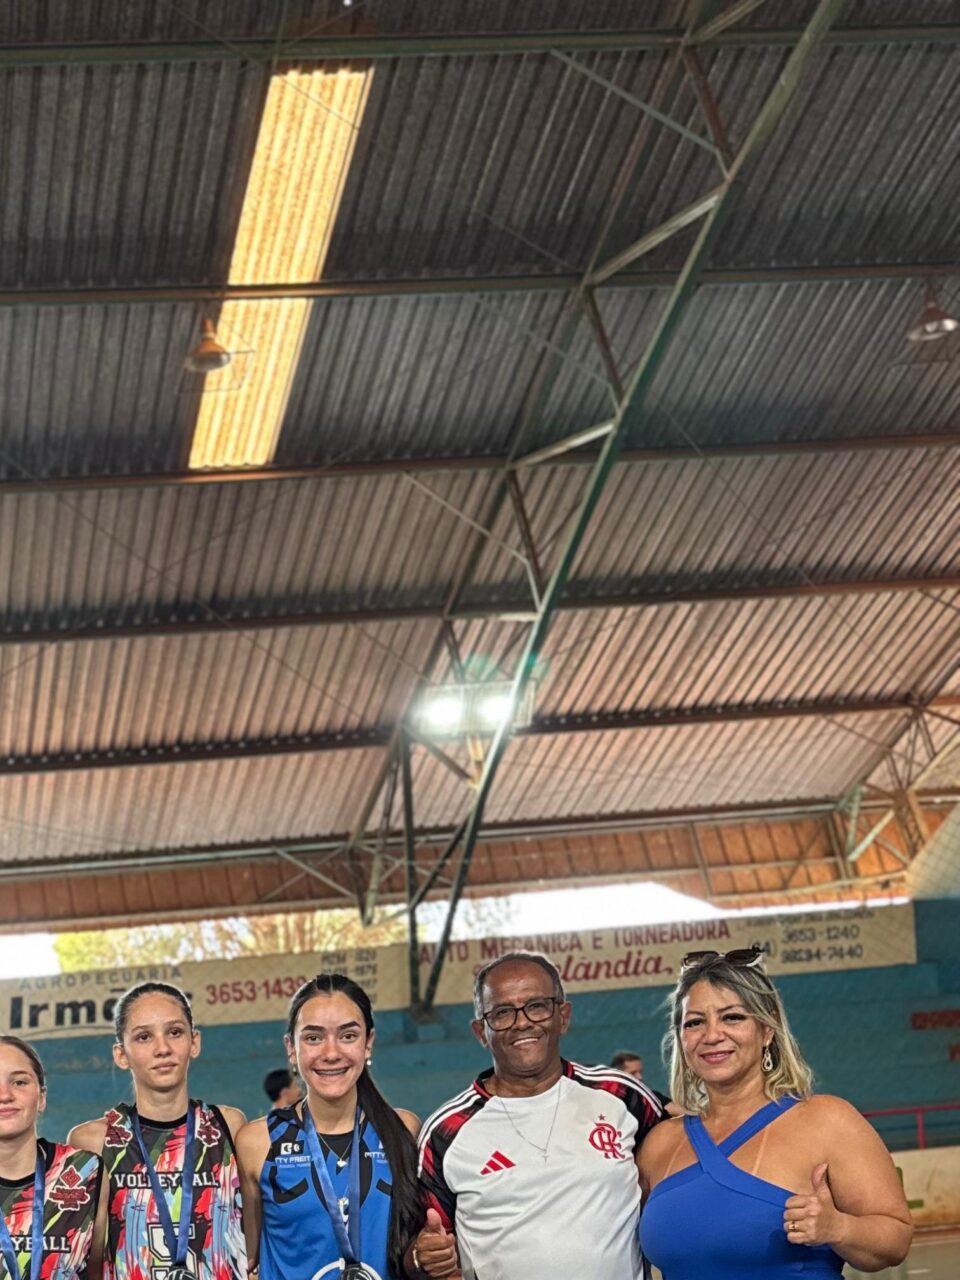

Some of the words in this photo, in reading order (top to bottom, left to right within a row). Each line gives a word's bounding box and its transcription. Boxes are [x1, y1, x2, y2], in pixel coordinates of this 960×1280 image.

[593, 928, 603, 950] E
[613, 916, 730, 947] TORNEADORA
[114, 1171, 220, 1188] VOLEYALL
